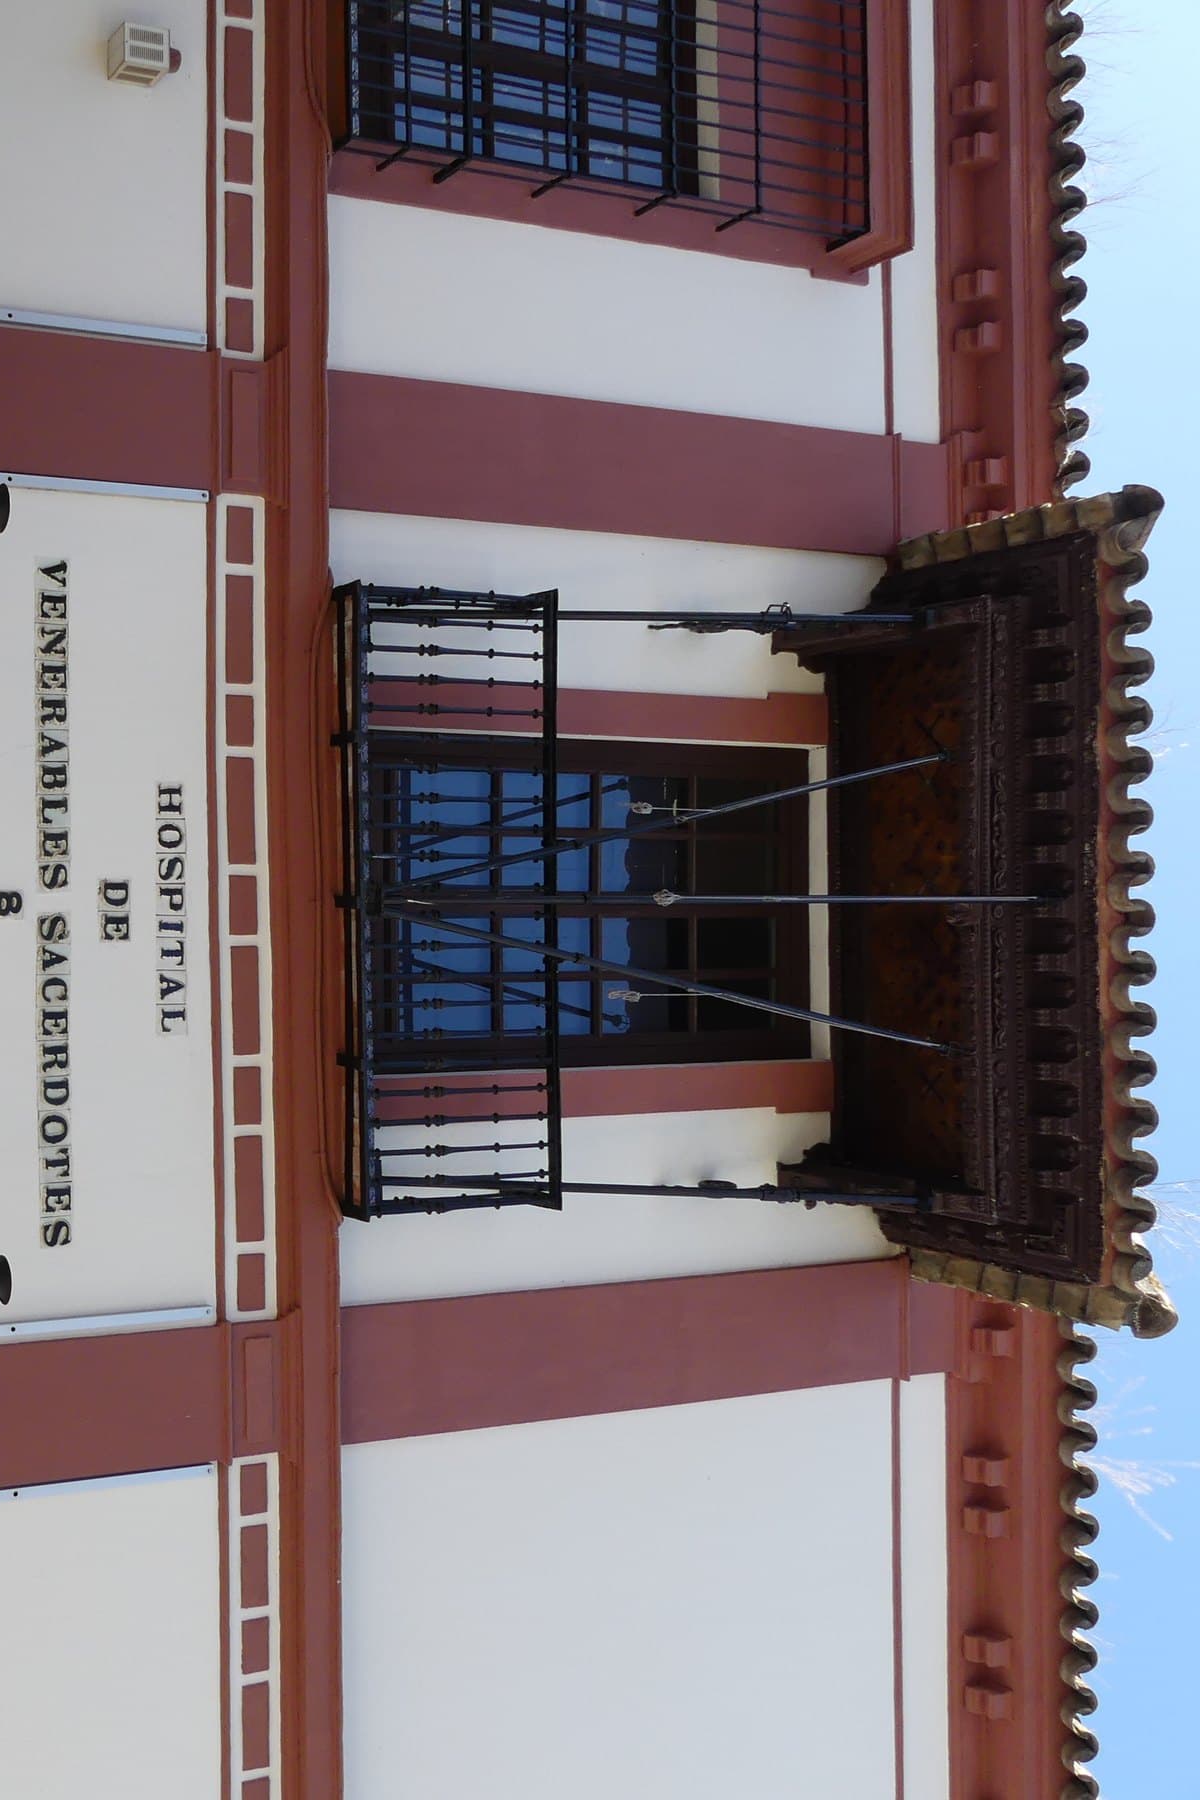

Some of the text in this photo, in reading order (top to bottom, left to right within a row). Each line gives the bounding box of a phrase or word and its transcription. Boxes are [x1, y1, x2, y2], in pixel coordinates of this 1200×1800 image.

[38, 560, 72, 1247] VENERABLES SACERDOTES
[102, 881, 130, 941] DE
[158, 784, 186, 1033] HOSPITAL
